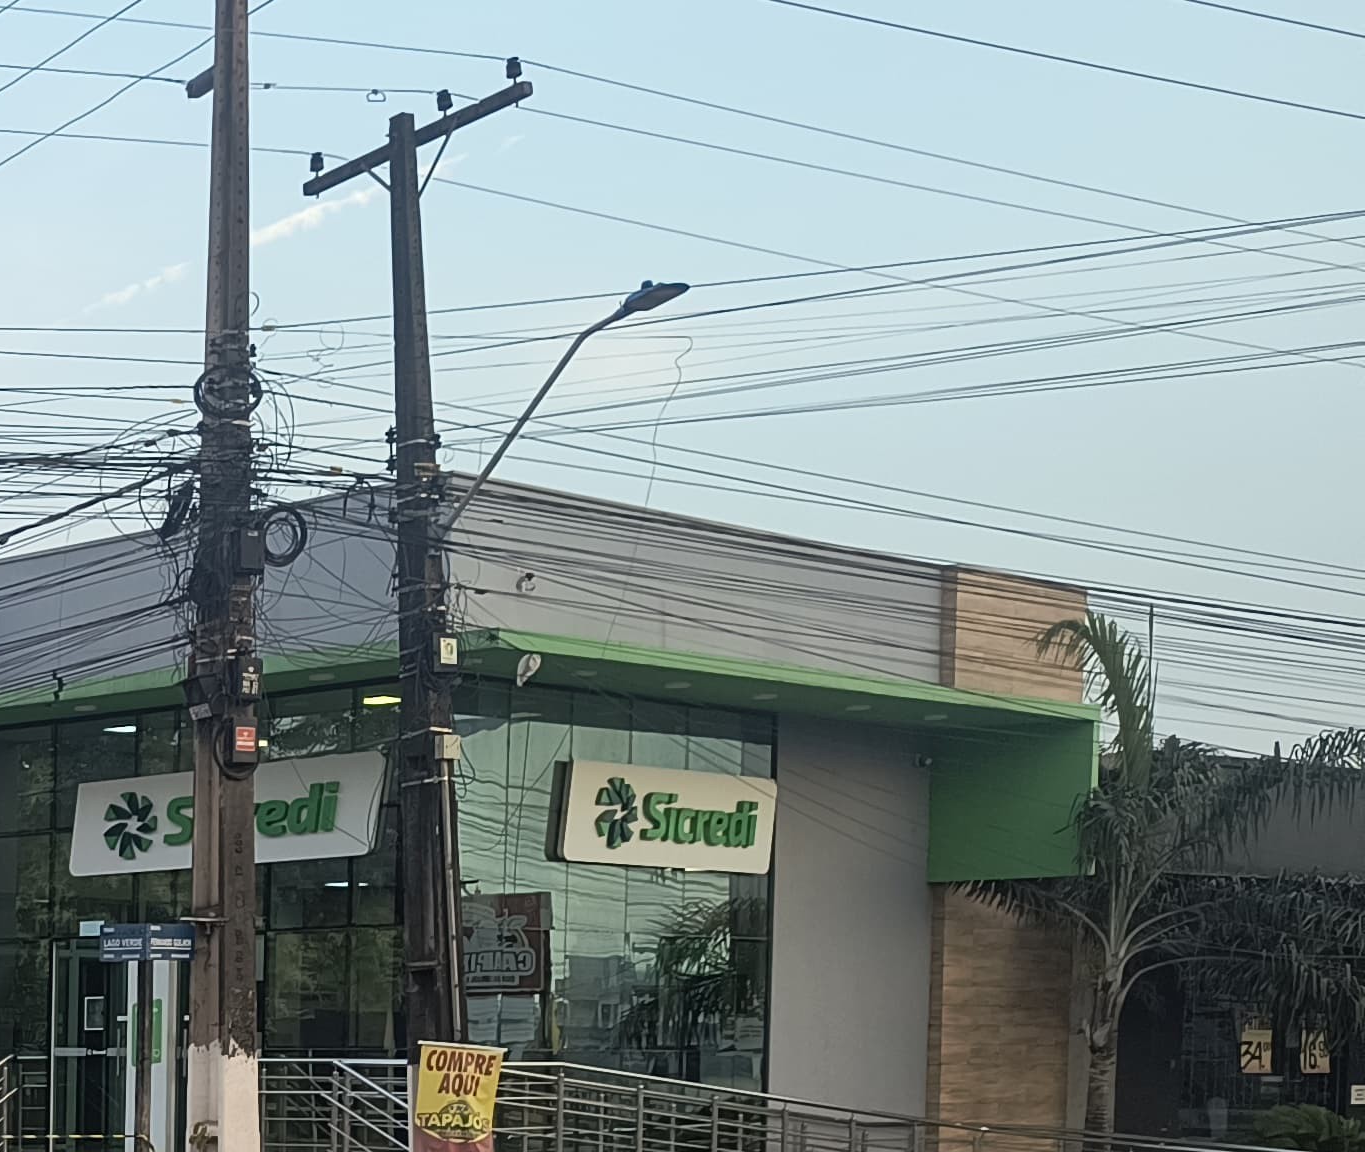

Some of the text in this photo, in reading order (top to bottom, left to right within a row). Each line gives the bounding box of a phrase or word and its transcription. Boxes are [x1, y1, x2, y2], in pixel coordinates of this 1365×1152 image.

[164, 781, 340, 846] Sedi
[640, 792, 759, 848] Sicredi
[426, 1050, 497, 1076] COMPRE
[438, 1073, 480, 1097] AQUI
